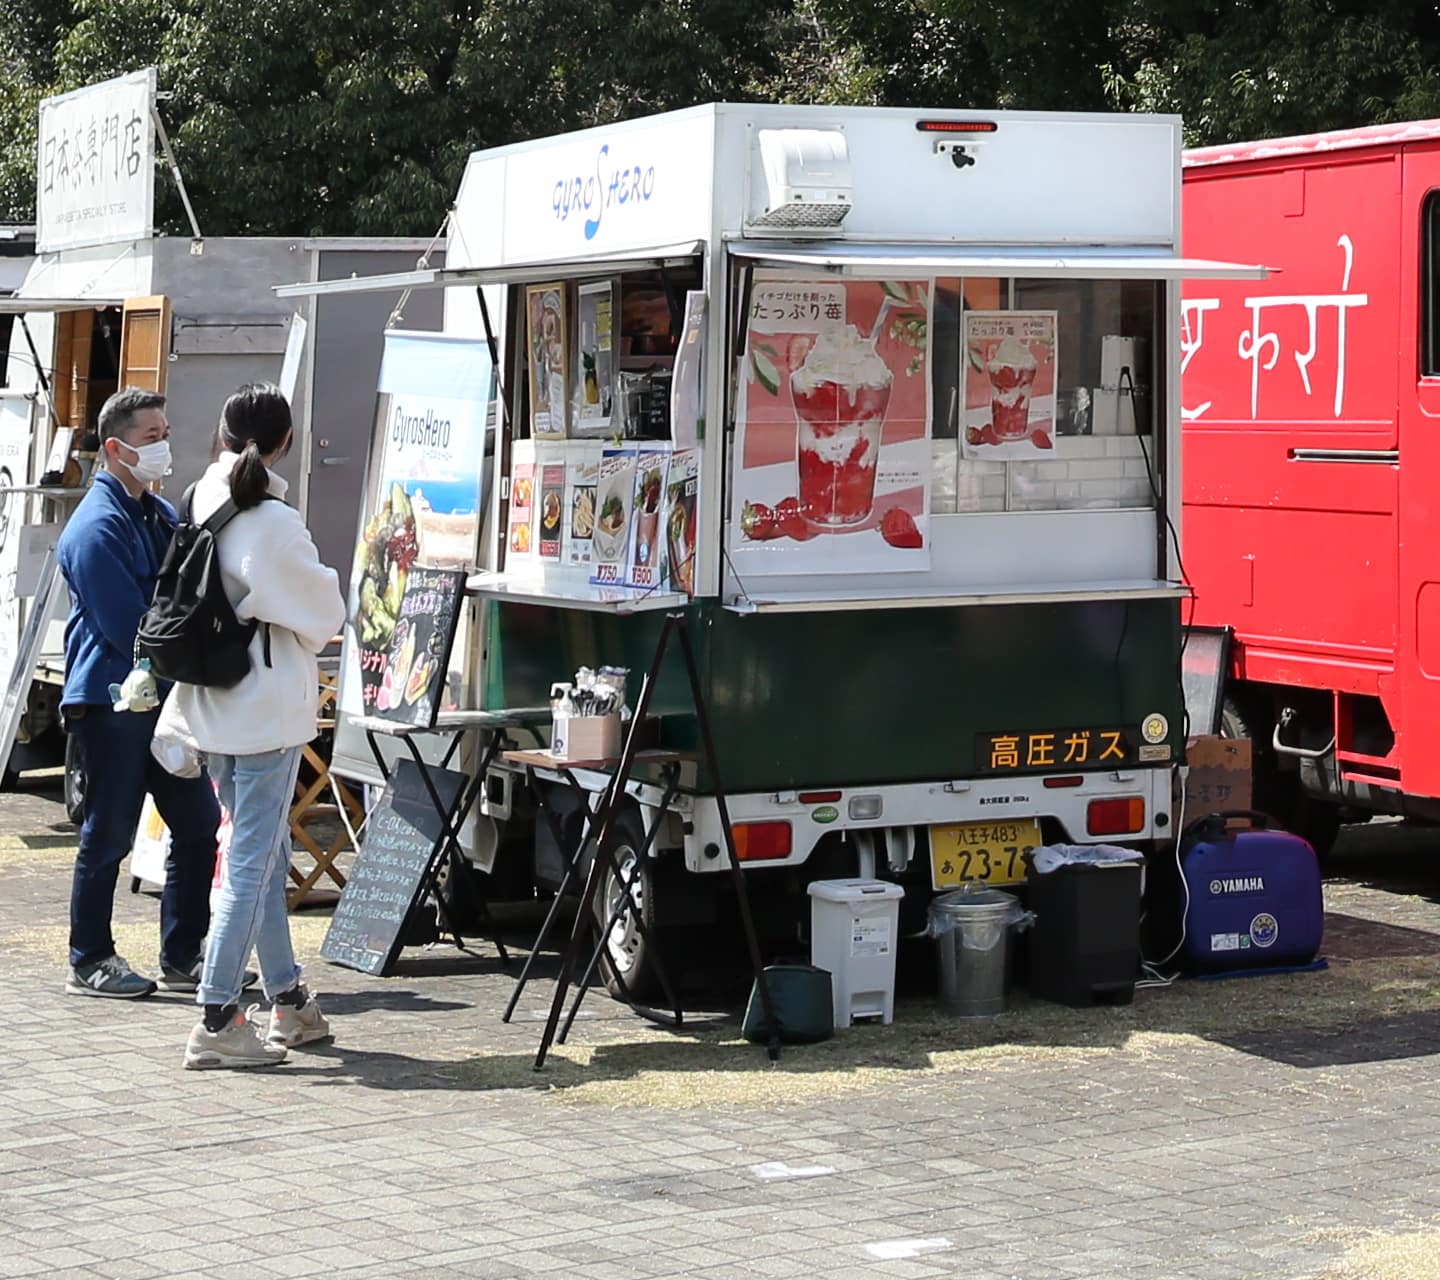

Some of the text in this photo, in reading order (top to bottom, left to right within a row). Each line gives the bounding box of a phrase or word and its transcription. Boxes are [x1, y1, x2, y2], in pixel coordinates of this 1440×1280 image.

[44, 108, 143, 195] 日本茶専門店
[752, 302, 843, 321] たっぷり苺
[392, 405, 451, 453] GyrosHero
[990, 730, 1125, 769] 高圧ガス
[941, 859, 954, 874] あ
[1222, 876, 1264, 893] YAMAHA
